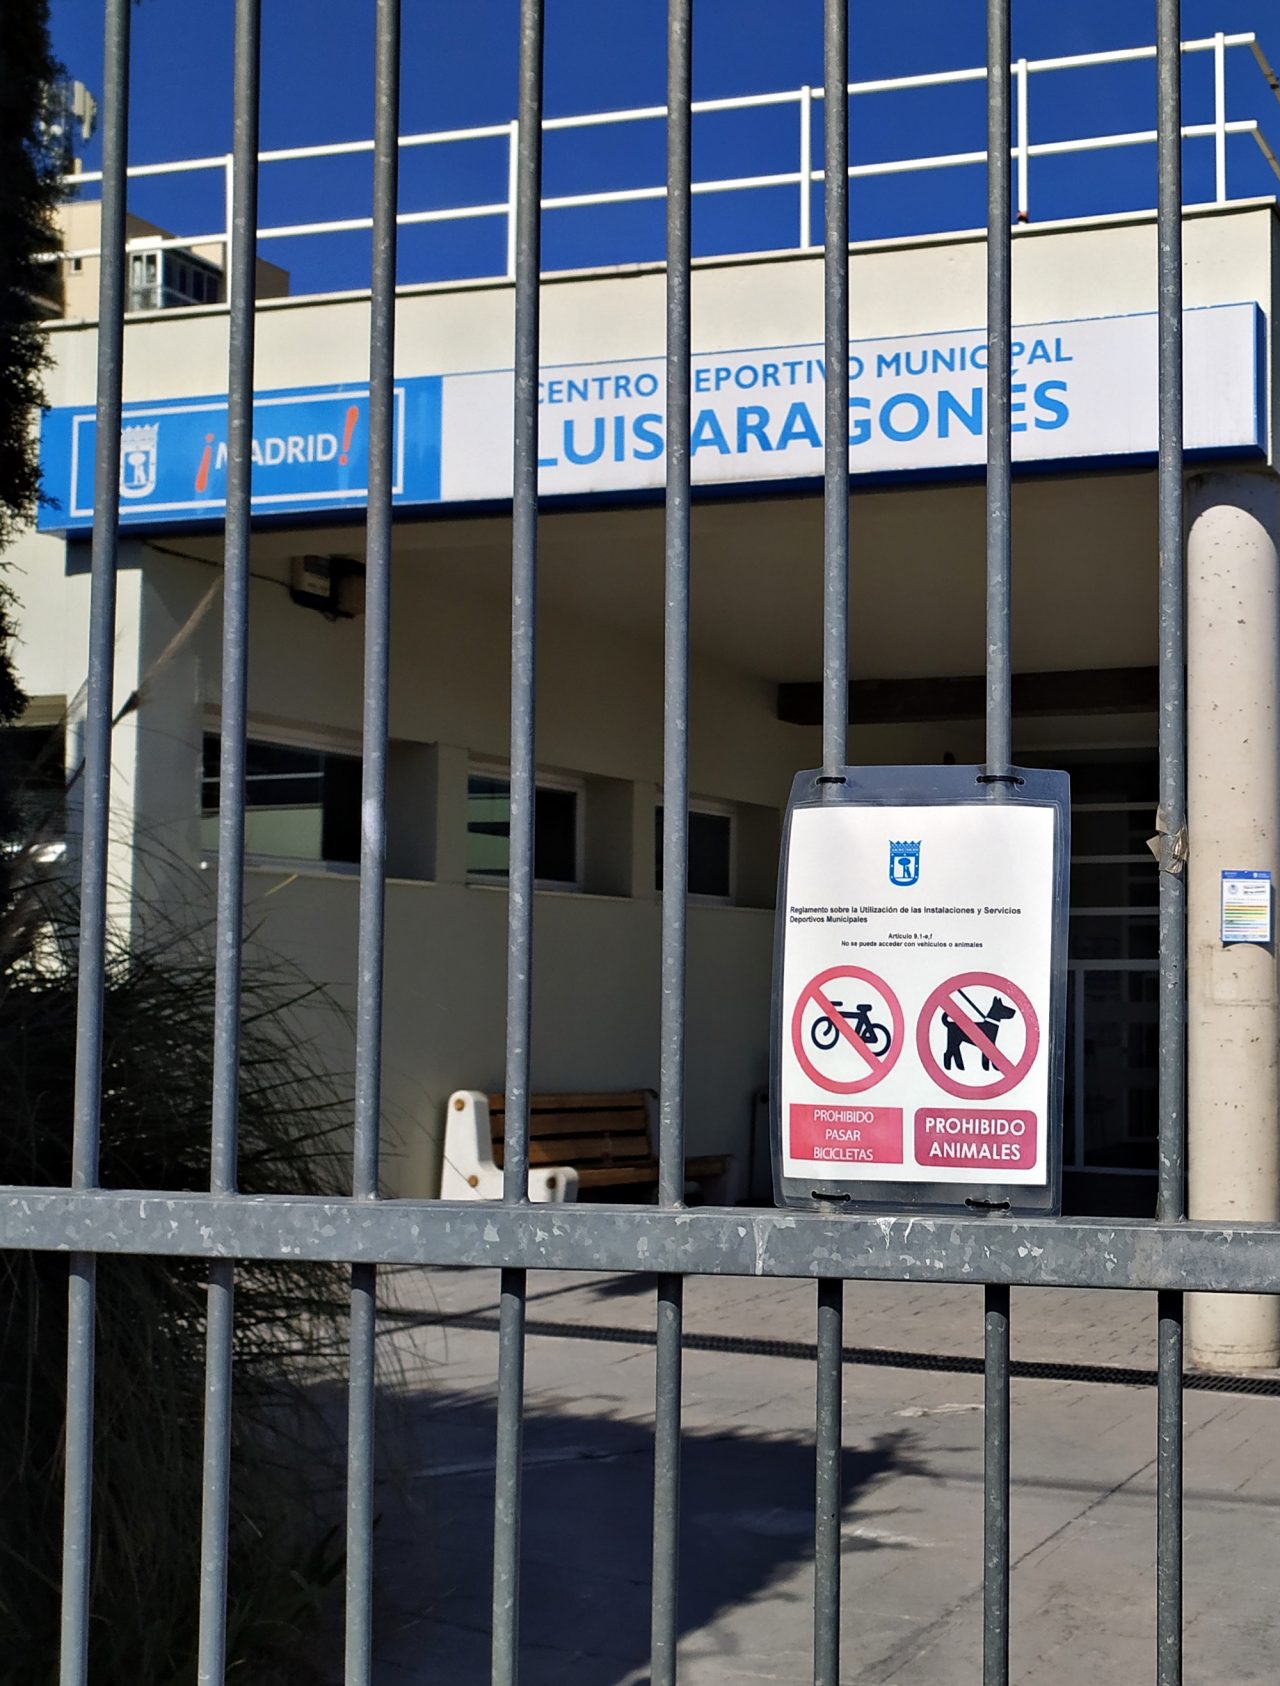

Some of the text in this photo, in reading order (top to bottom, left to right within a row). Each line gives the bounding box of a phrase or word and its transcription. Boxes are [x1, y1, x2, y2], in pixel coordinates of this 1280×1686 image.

[538, 337, 1073, 405] ENTRO EPORTIO MUNICPAL
[790, 905, 1022, 916] Reglamento sobre la Utilización de las Instalaciones y Servicios
[789, 915, 868, 925] Deportivos Municipales
[859, 940, 877, 948] puede
[878, 940, 903, 948] acceder
[954, 941, 983, 949] animales
[813, 1109, 874, 1125] PROHIBIDO
[925, 1117, 1026, 1137] PROHIBIDO
[825, 1129, 861, 1142] PASAR
[813, 1147, 874, 1162] BICICLETAS
[929, 1142, 1021, 1161] ANIMALES
